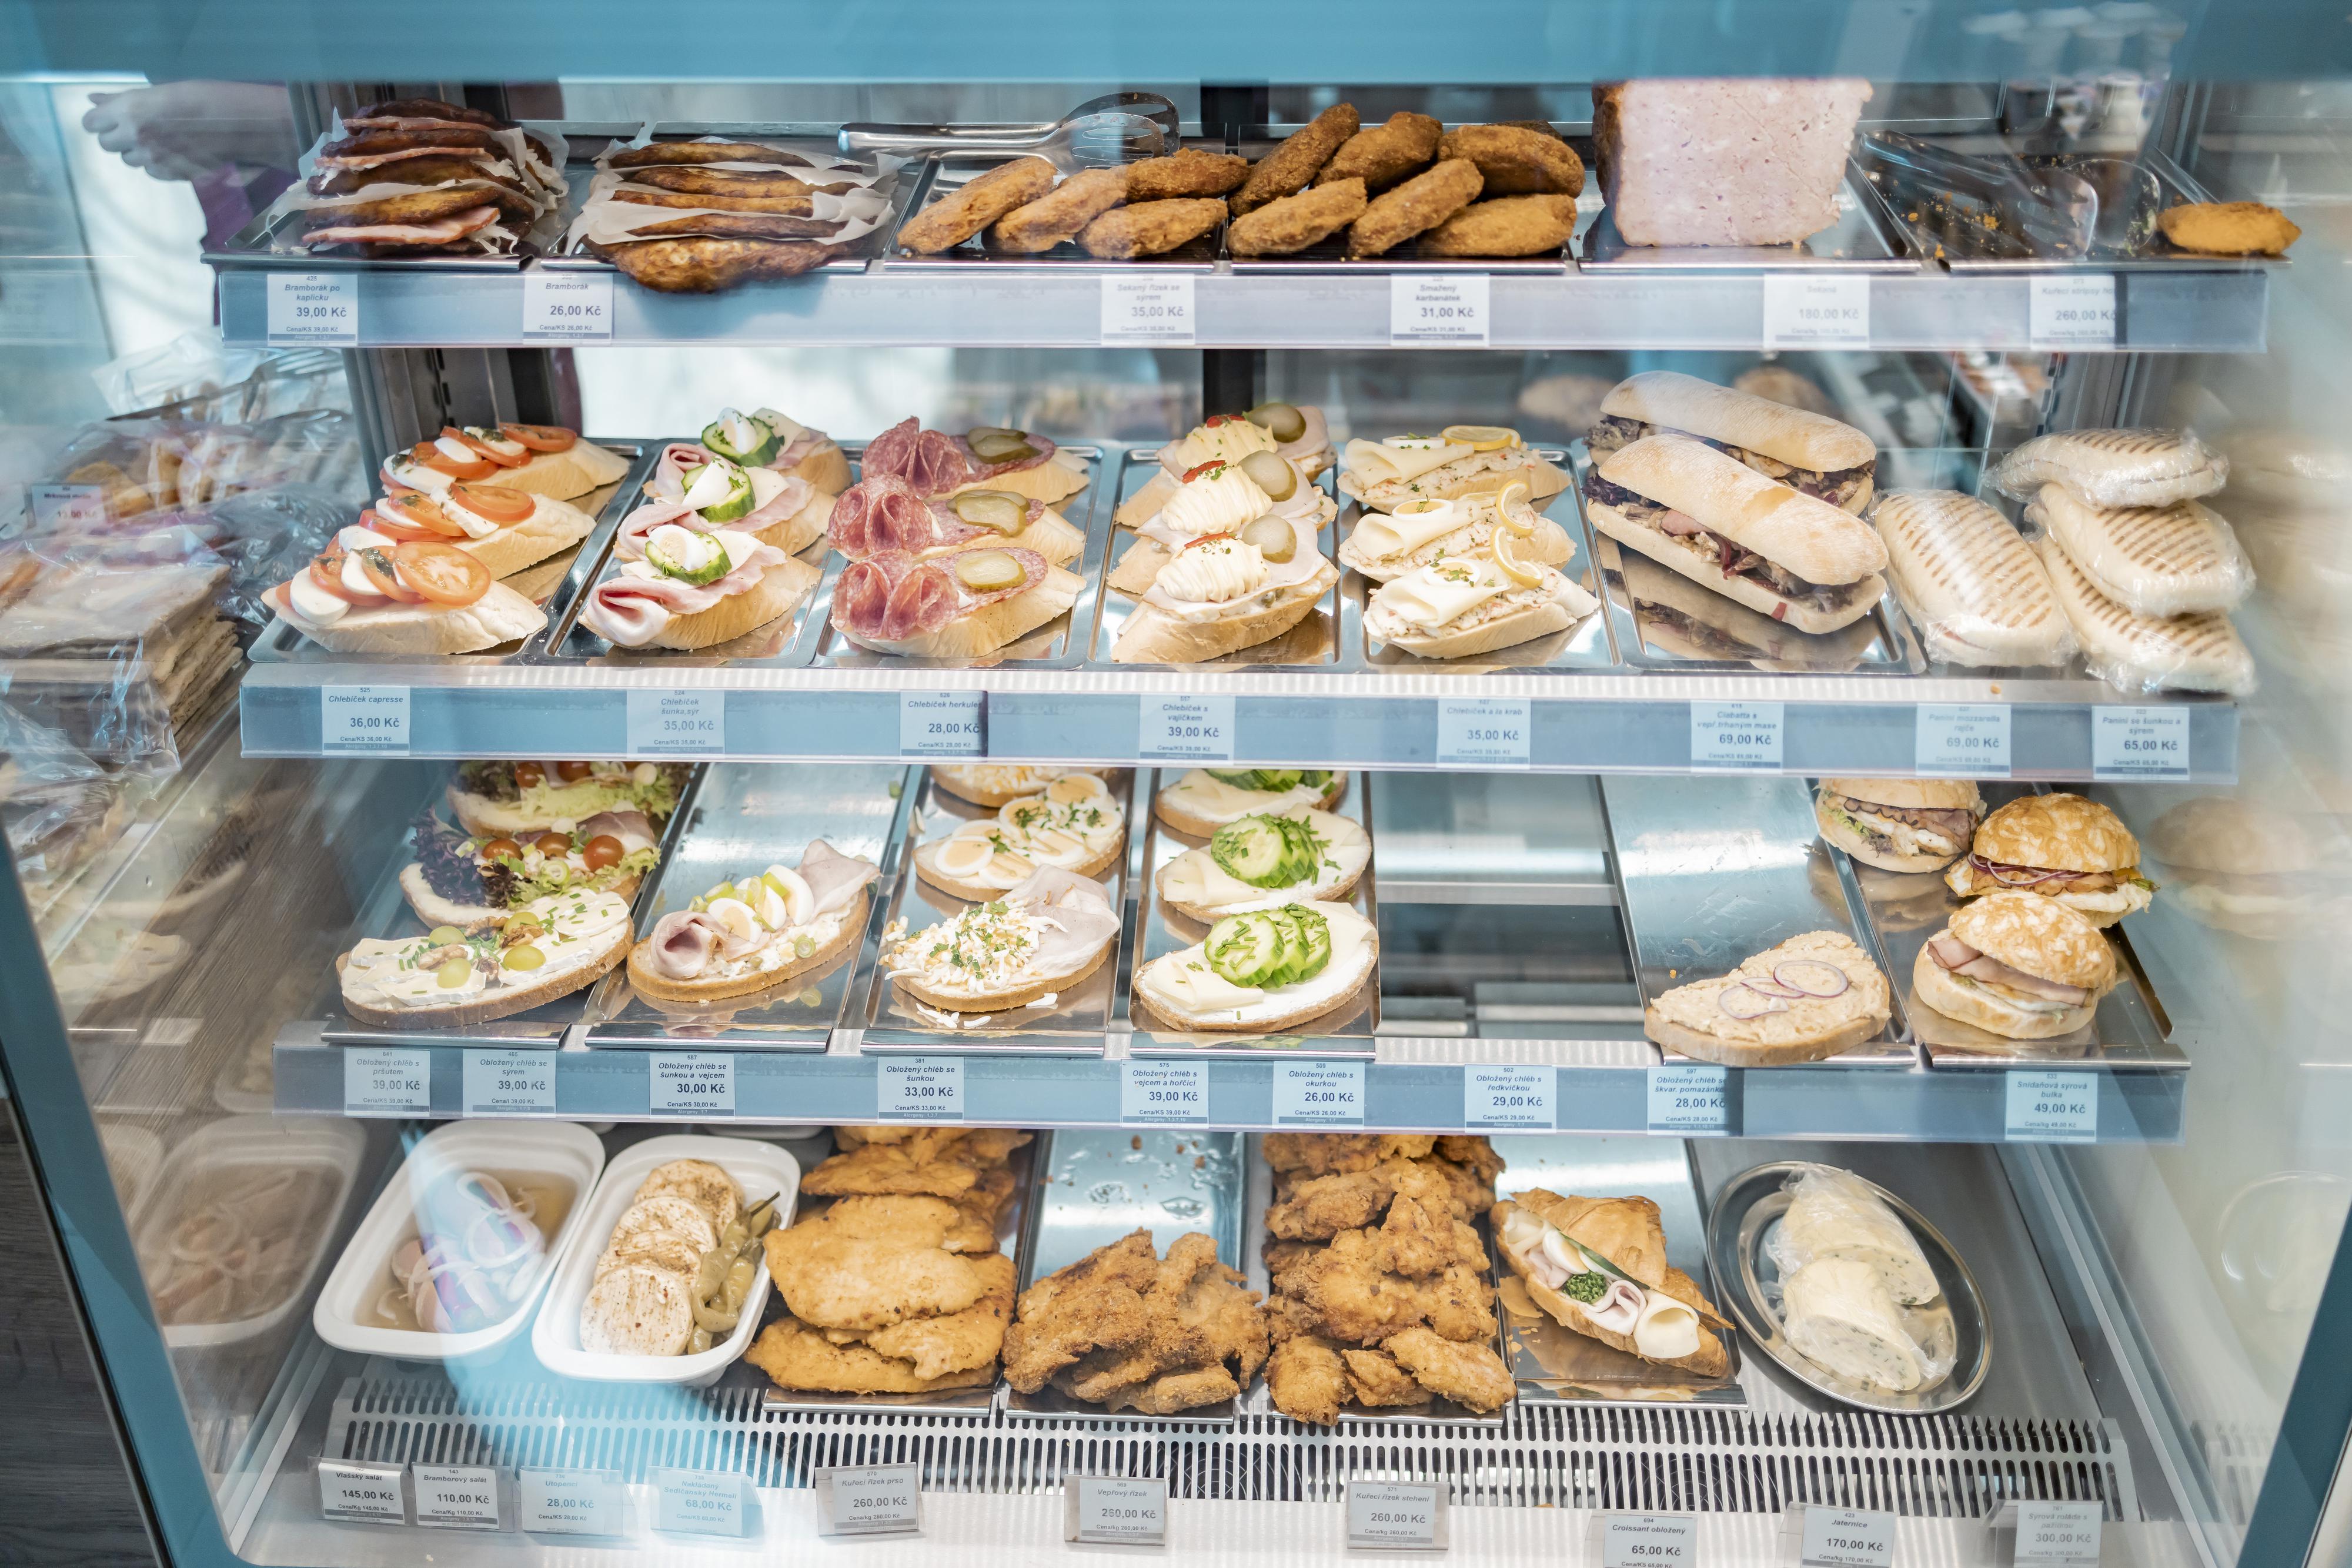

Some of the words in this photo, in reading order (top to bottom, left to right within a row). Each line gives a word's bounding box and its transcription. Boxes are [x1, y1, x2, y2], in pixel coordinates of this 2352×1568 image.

[296, 307, 326, 318] 39,00
[331, 307, 347, 317] Kč
[550, 306, 581, 317] 26,00
[586, 306, 601, 315] Kč
[1132, 307, 1163, 317] 35,00
[1168, 306, 1184, 316] Kč
[1421, 308, 1453, 318] 31,00
[1458, 308, 1474, 317] Kč
[1843, 309, 1859, 319] Kč
[350, 718, 380, 728] 36,00
[385, 718, 400, 727] Kč
[664, 721, 694, 731] 35,00
[699, 721, 714, 730] Kč
[928, 724, 959, 734] 28,00
[964, 724, 980, 733] Kč
[1169, 727, 1199, 738] 39,00
[1204, 727, 1219, 737] Kč
[1468, 730, 1498, 741] 35,00
[1504, 730, 1519, 740] Kč
[1720, 734, 1750, 745] 69,00
[1756, 735, 1772, 745] Kč
[1947, 738, 1979, 748] 69,00
[1984, 738, 1999, 748] Kč
[2124, 741, 2156, 751] 65,00
[2161, 741, 2177, 750] Kč
[1476, 1075, 1512, 1083] Obložený
[373, 1080, 402, 1091] 39,00
[406, 1081, 420, 1090] Kč
[499, 1081, 527, 1091] 39,00
[531, 1081, 546, 1090] Kč
[677, 1084, 706, 1094] 30,00
[711, 1084, 725, 1093] Kč
[905, 1087, 934, 1098] 33,00
[938, 1087, 954, 1096] Kč
[1149, 1092, 1178, 1102] 39,00
[1183, 1092, 1198, 1101] Kč
[1305, 1092, 1334, 1103] 26,00
[1339, 1093, 1354, 1102] Kč
[1493, 1096, 1523, 1108] 29,00
[1528, 1097, 1542, 1106] Kč
[1676, 1099, 1705, 1109] 28,00
[2034, 1104, 2065, 1114] 49,00
[2070, 1104, 2086, 1114] Kč
[424, 1475, 467, 1483] Bramborový
[342, 1490, 376, 1500] 145,00
[380, 1492, 395, 1500] Kč
[1097, 1489, 1127, 1497] Vepřový
[437, 1494, 472, 1503] 110,00
[476, 1495, 489, 1504] Kč
[547, 1499, 576, 1509] 28,00
[580, 1500, 594, 1508] Kč
[853, 1498, 889, 1507] 260,00
[893, 1496, 907, 1506] Kč
[686, 1499, 714, 1510] 68,00
[718, 1502, 732, 1511] Kč
[1141, 1510, 1156, 1519] Kč
[1371, 1513, 1407, 1523] 260,00
[1411, 1514, 1426, 1523] Kč
[1832, 1520, 1867, 1528] Jaternice
[2036, 1533, 2072, 1543] 300,00
[2076, 1534, 2091, 1543] Kč
[1826, 1538, 1863, 1549] 170,00
[1868, 1541, 1883, 1551] Kč
[1632, 1546, 1662, 1556] 65,00
[1666, 1547, 1681, 1556] Kč
